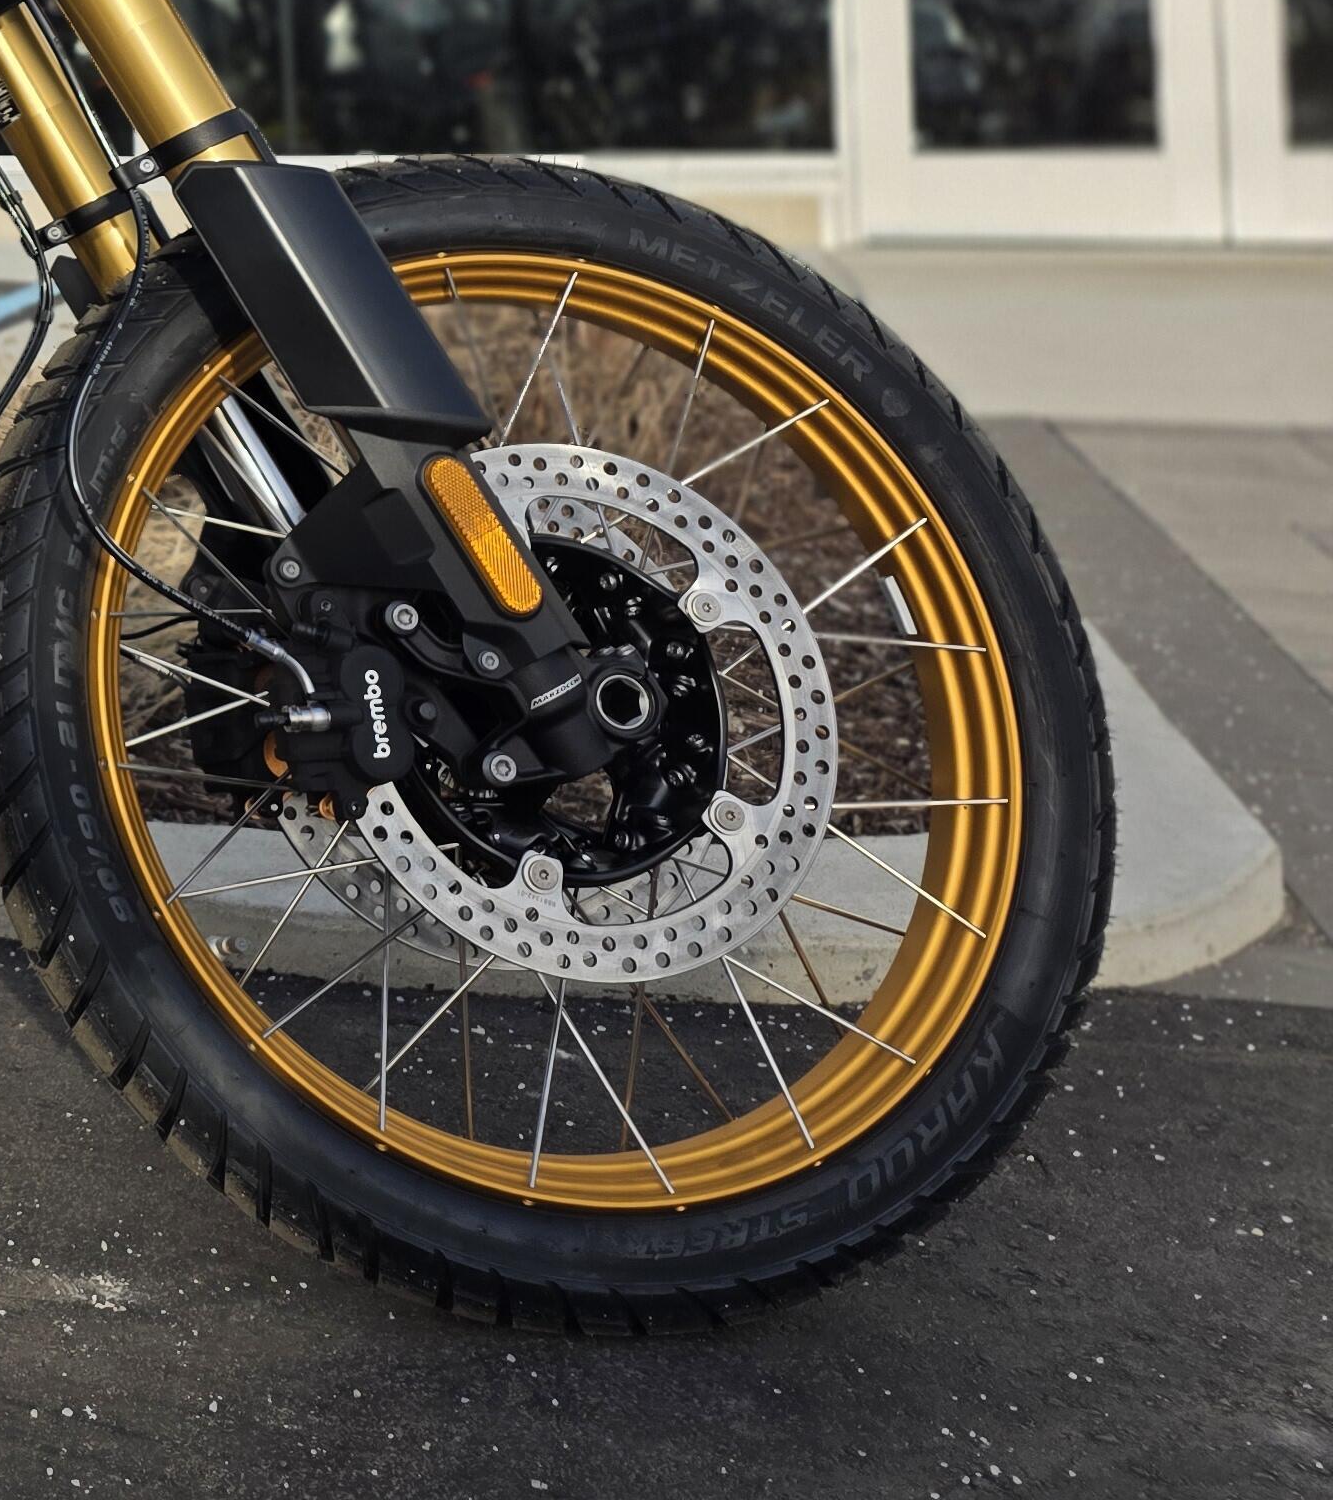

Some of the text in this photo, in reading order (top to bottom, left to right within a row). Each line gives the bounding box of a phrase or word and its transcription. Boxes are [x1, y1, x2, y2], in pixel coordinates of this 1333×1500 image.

[629, 228, 874, 382] METZELER
[364, 668, 391, 760] brembo
[845, 1030, 1007, 1210] KAROO
